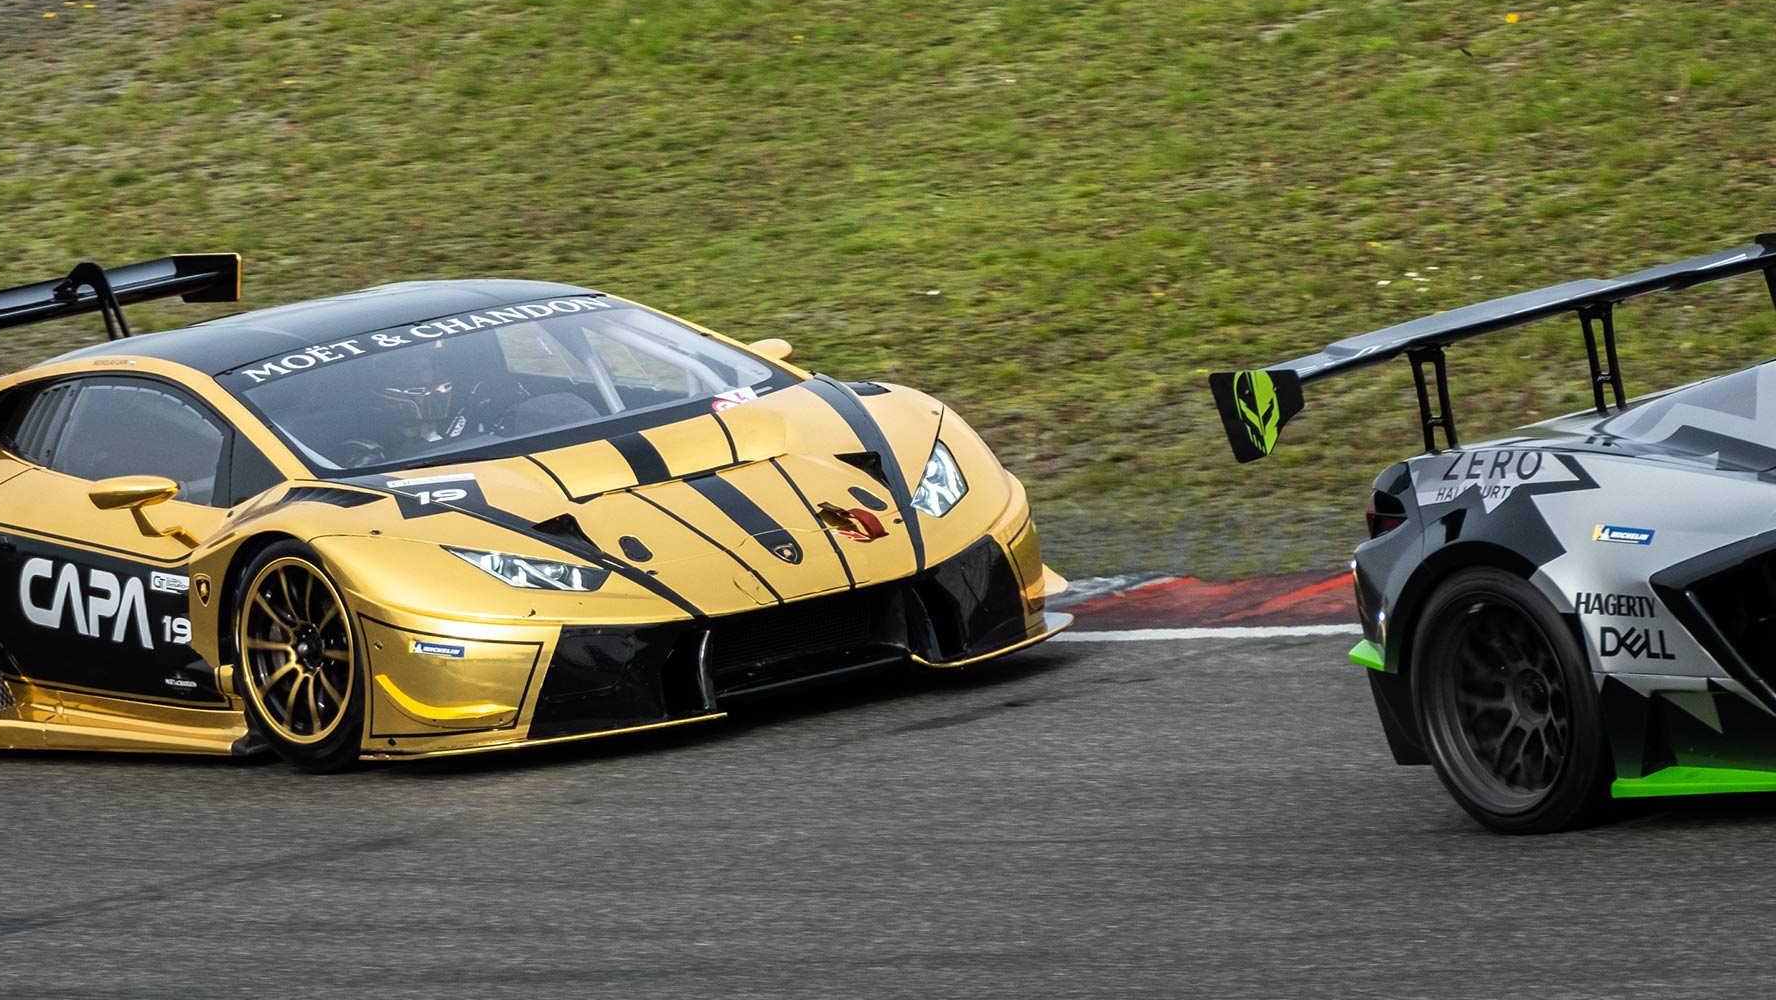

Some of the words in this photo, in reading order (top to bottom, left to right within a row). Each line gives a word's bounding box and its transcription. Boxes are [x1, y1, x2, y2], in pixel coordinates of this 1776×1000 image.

[241, 338, 367, 384] MOËT
[370, 333, 413, 349] &
[409, 296, 612, 341] CHANDON
[1442, 450, 1544, 481] ZERO
[416, 488, 467, 505] 19
[19, 557, 155, 650] CAPA
[1574, 591, 1656, 618] HAGERTY
[162, 615, 192, 645] 19
[1599, 626, 1677, 660] DELL
